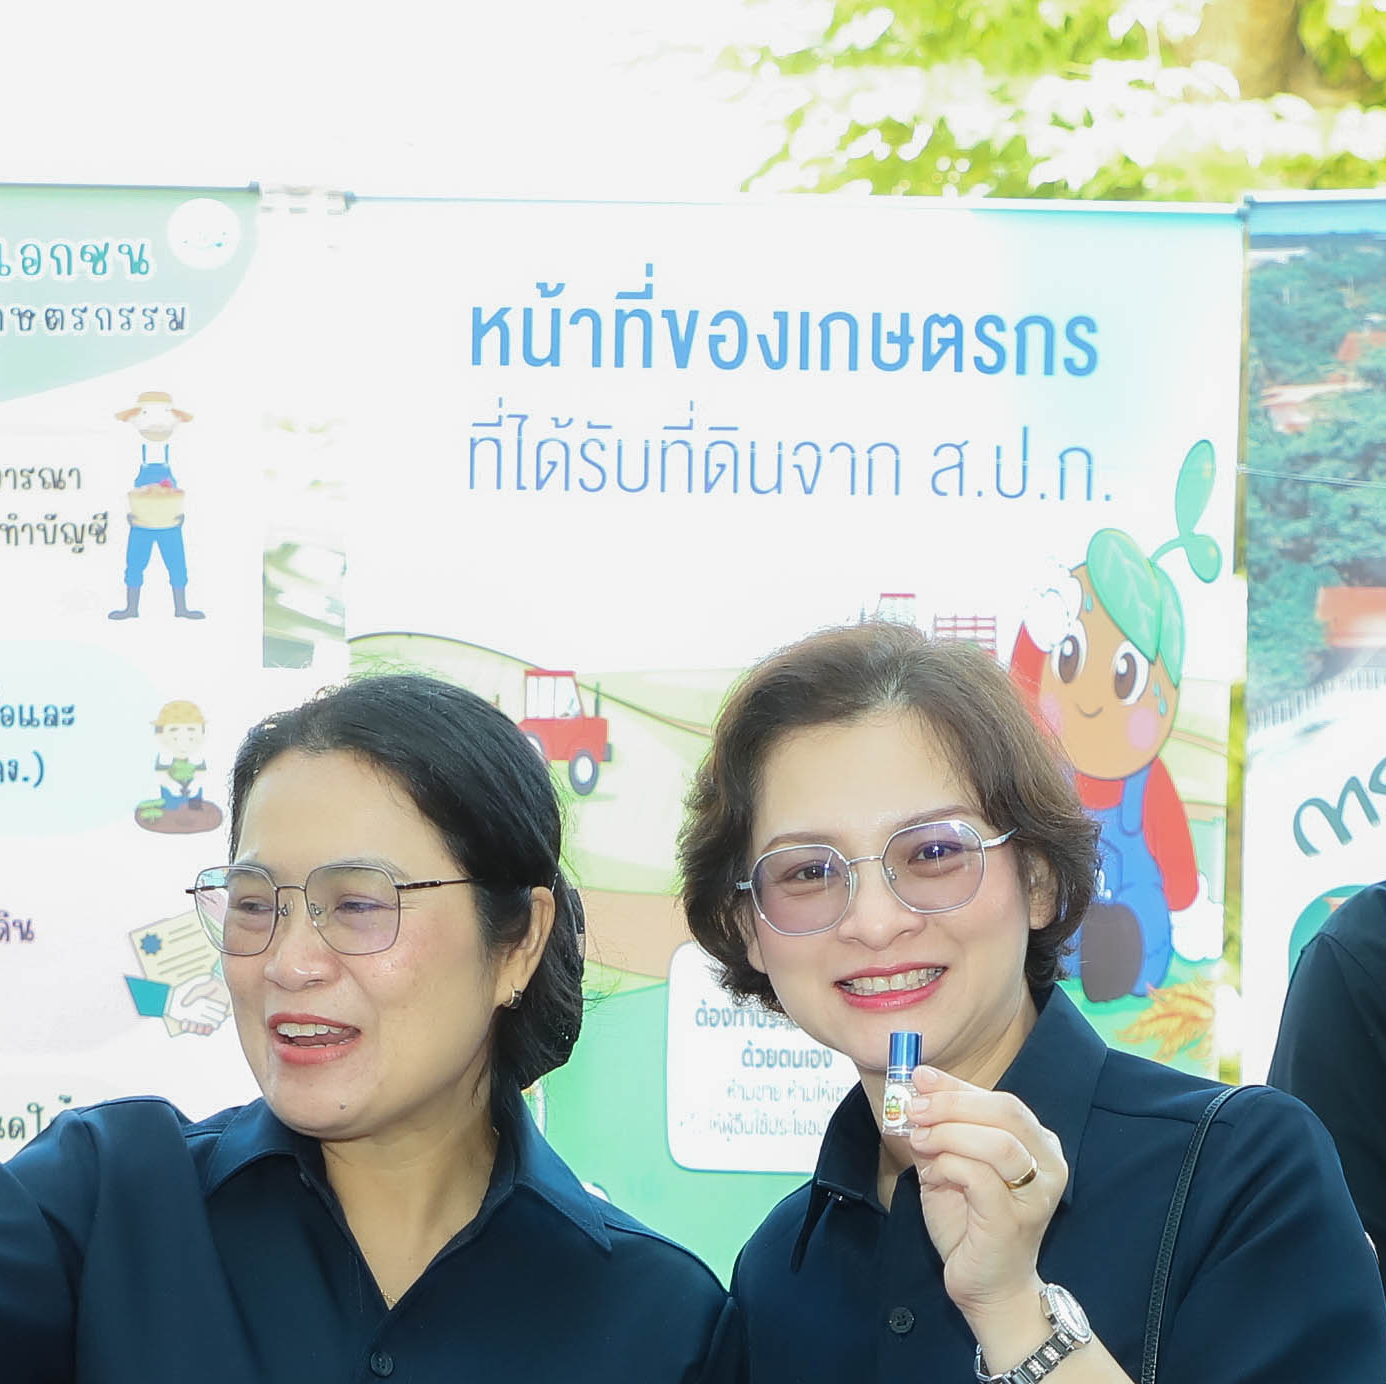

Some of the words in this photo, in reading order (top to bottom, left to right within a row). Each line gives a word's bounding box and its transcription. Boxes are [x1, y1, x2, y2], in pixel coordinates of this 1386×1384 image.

[469, 263, 1100, 377] หน้าที่ของเกษตรกร
[469, 397, 901, 496] ที่ได้รับที่ดินจาก
[930, 425, 1112, 501] ส.ป.ก.
